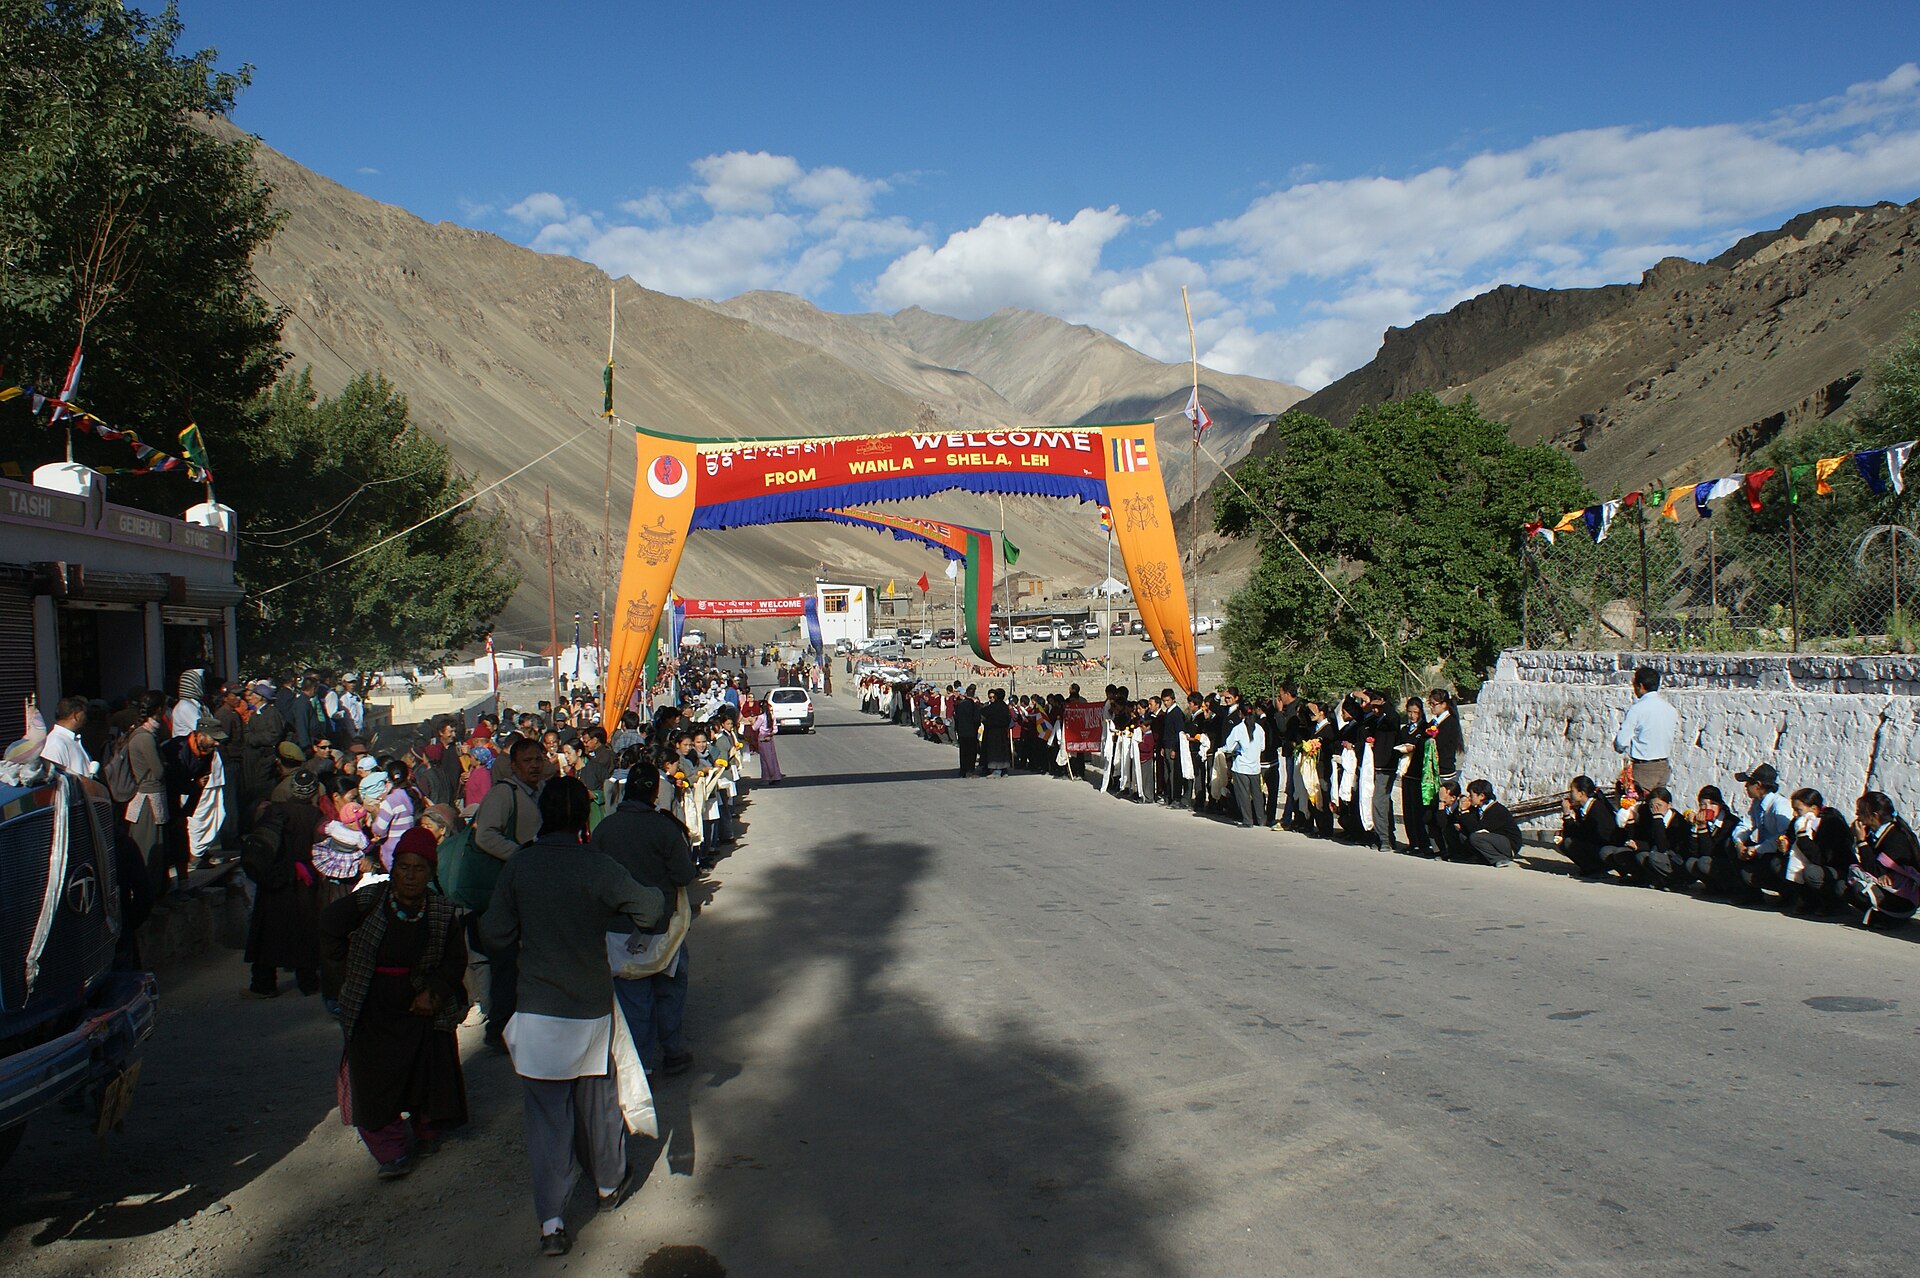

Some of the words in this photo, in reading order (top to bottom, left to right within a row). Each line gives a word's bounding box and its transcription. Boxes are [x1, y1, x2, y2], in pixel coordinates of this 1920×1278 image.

[910, 432, 1091, 452] WELCOME
[764, 467, 817, 487] FROM
[848, 457, 915, 475] WANLA
[946, 453, 1013, 467] SHELA,
[1021, 453, 1050, 467] LEH
[8, 491, 51, 519] TASHI
[119, 514, 163, 540] GENERAL
[185, 529, 210, 549] STORE
[759, 600, 802, 608] WELCOME
